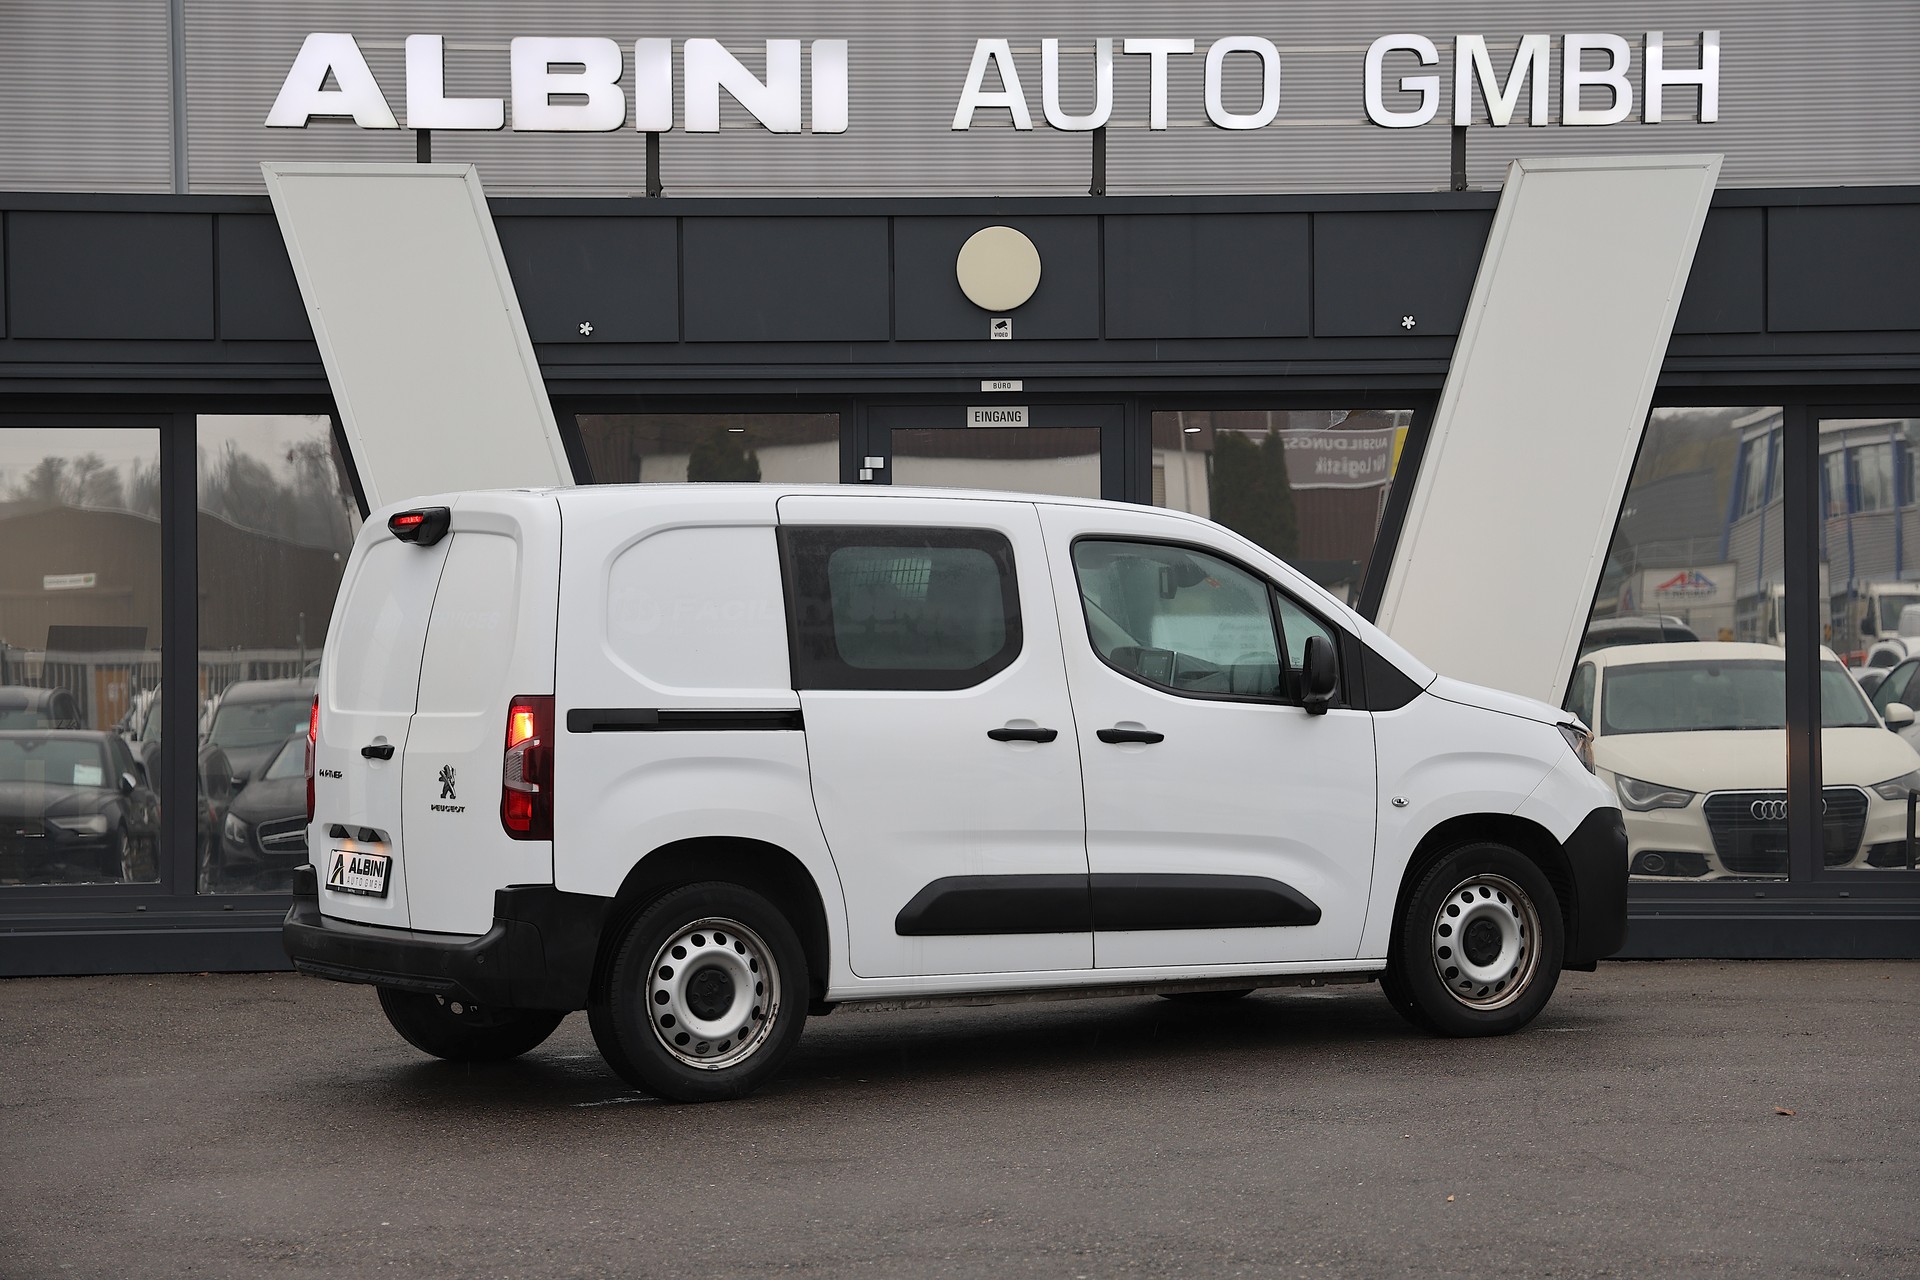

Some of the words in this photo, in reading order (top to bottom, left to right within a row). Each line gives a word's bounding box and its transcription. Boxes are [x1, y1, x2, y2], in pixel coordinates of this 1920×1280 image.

[265, 32, 848, 134] ALBINI
[951, 35, 1281, 131] AUTO
[1363, 30, 1721, 127] GMBH
[993, 381, 1011, 389] BÜRO
[974, 411, 1022, 422] EINGANG
[430, 804, 465, 813] PEUGEOT
[349, 857, 385, 878] ALBINI
[347, 876, 363, 887] AUTO
[364, 878, 382, 890] GMBH
